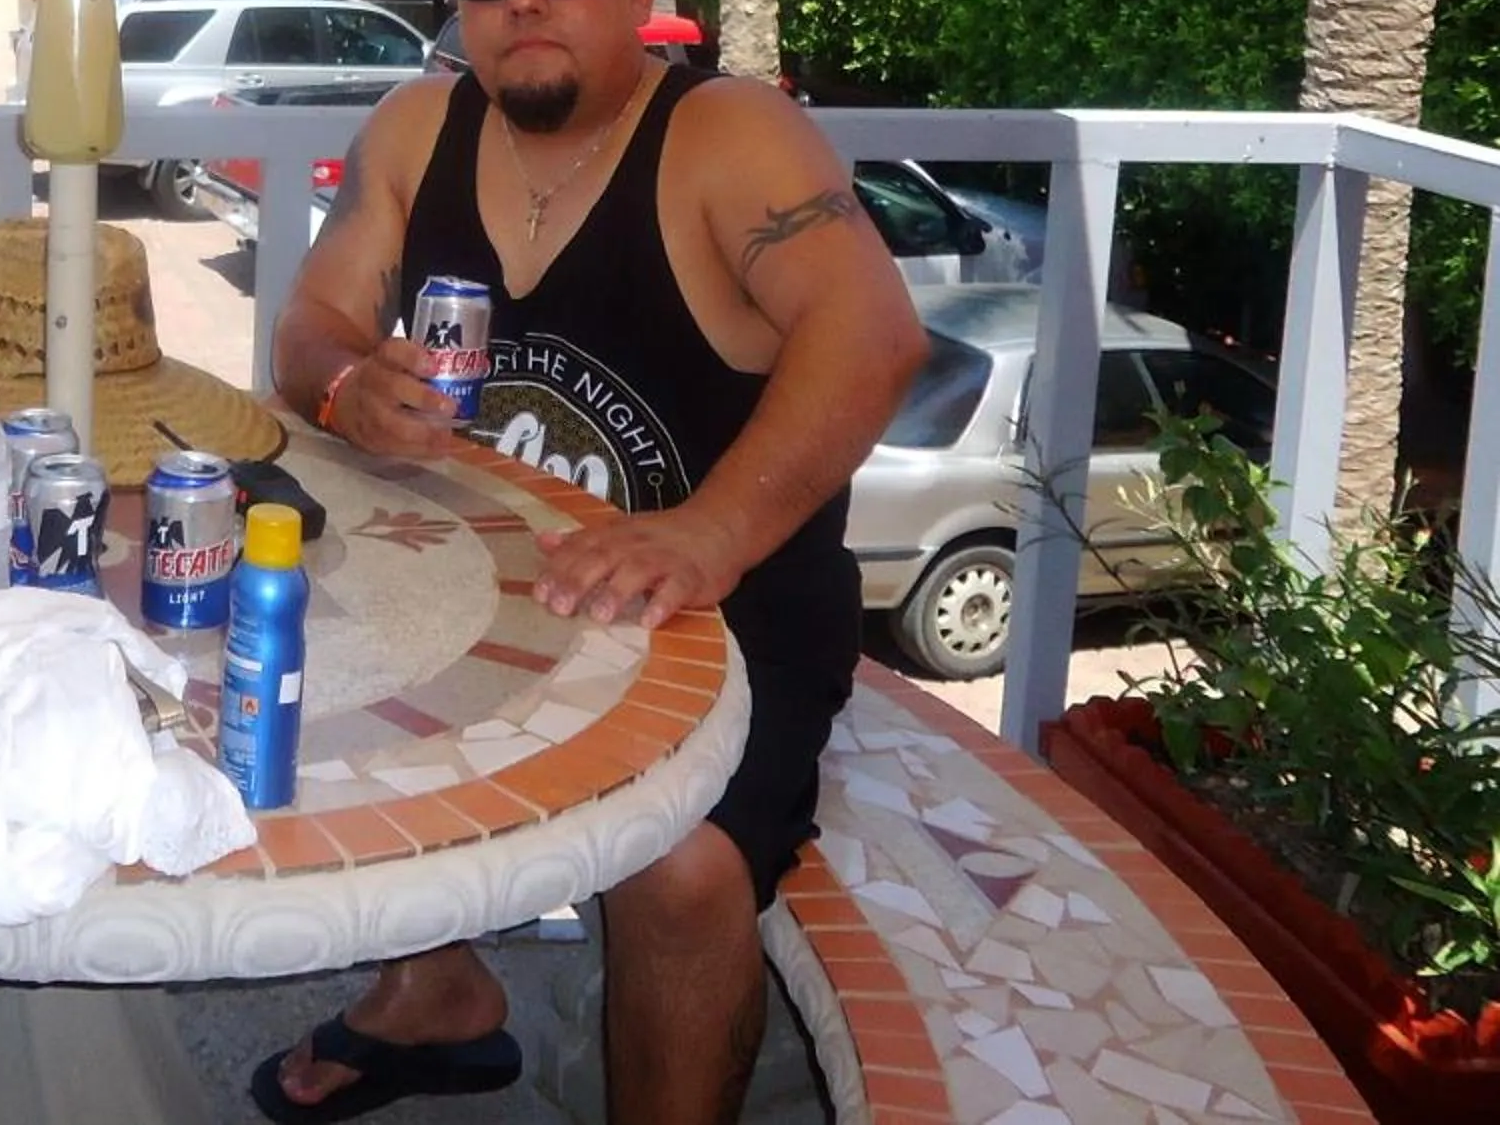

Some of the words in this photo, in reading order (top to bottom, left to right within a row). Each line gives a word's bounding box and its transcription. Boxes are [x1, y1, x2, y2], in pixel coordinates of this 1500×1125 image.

[573, 371, 667, 470] NIGHT
[148, 538, 231, 580] TECATE
[168, 590, 206, 605] LIGHT
